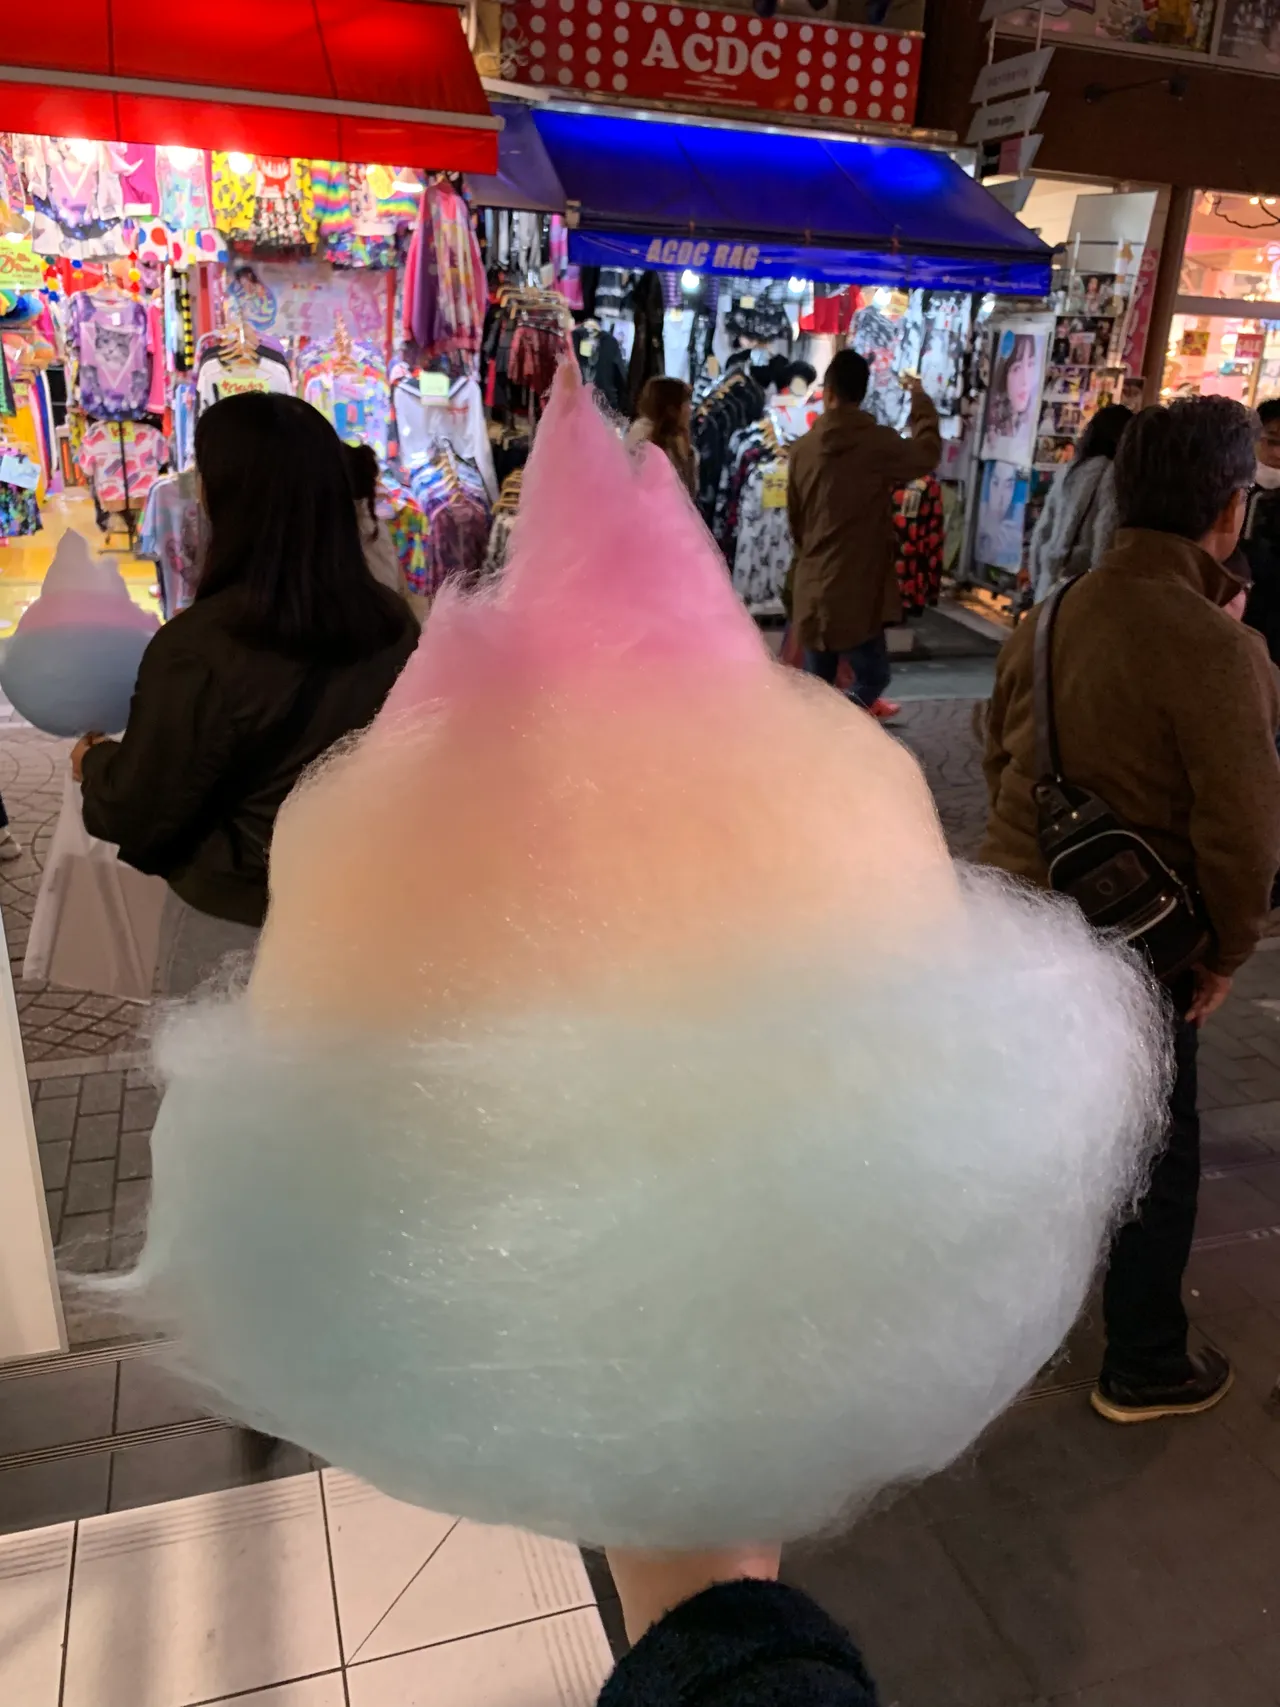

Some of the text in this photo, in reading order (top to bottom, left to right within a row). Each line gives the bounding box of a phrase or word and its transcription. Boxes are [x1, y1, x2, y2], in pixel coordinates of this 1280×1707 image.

[641, 27, 782, 80] ACDC
[645, 238, 760, 271] ACDC RAG
